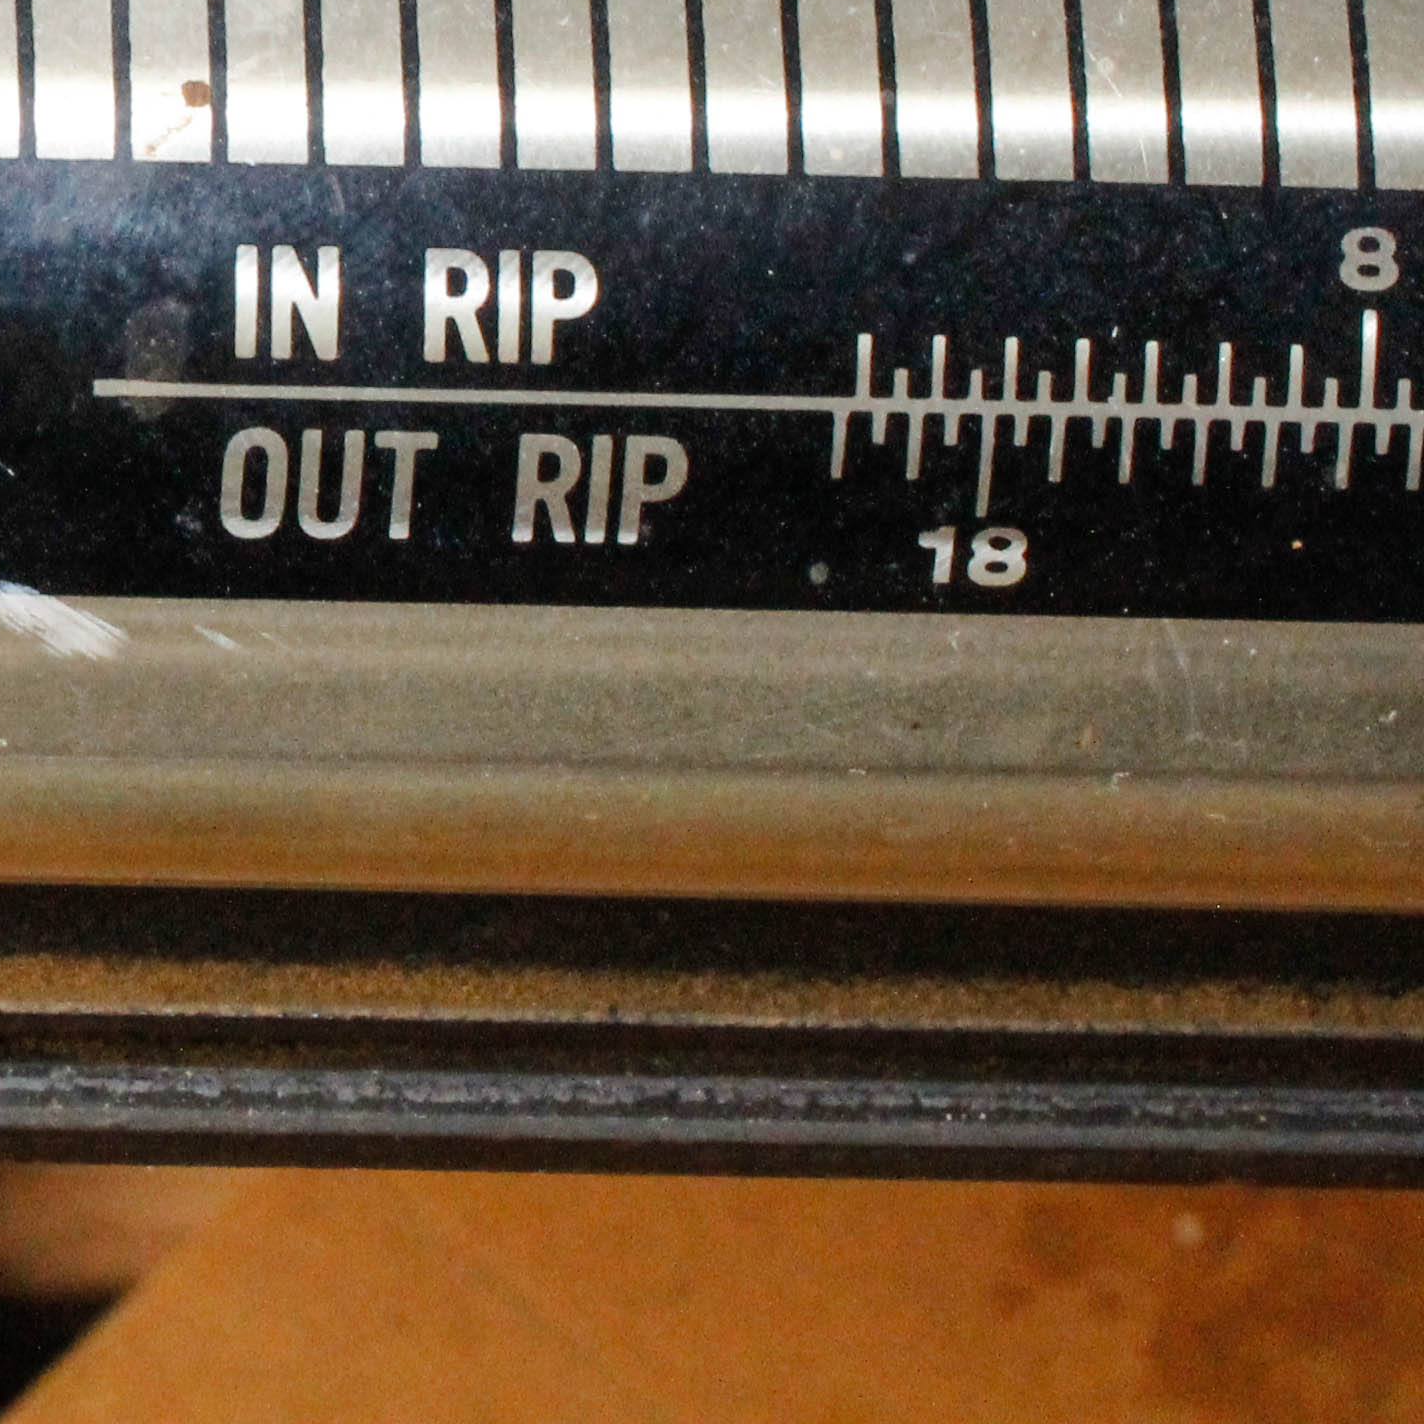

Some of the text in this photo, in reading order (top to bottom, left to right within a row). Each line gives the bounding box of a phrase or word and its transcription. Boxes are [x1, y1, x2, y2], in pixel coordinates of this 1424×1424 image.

[233, 243, 600, 365] IN RIP
[1338, 226, 1400, 292] 8
[218, 426, 690, 546] OUT RIP
[917, 525, 1029, 588] 18
